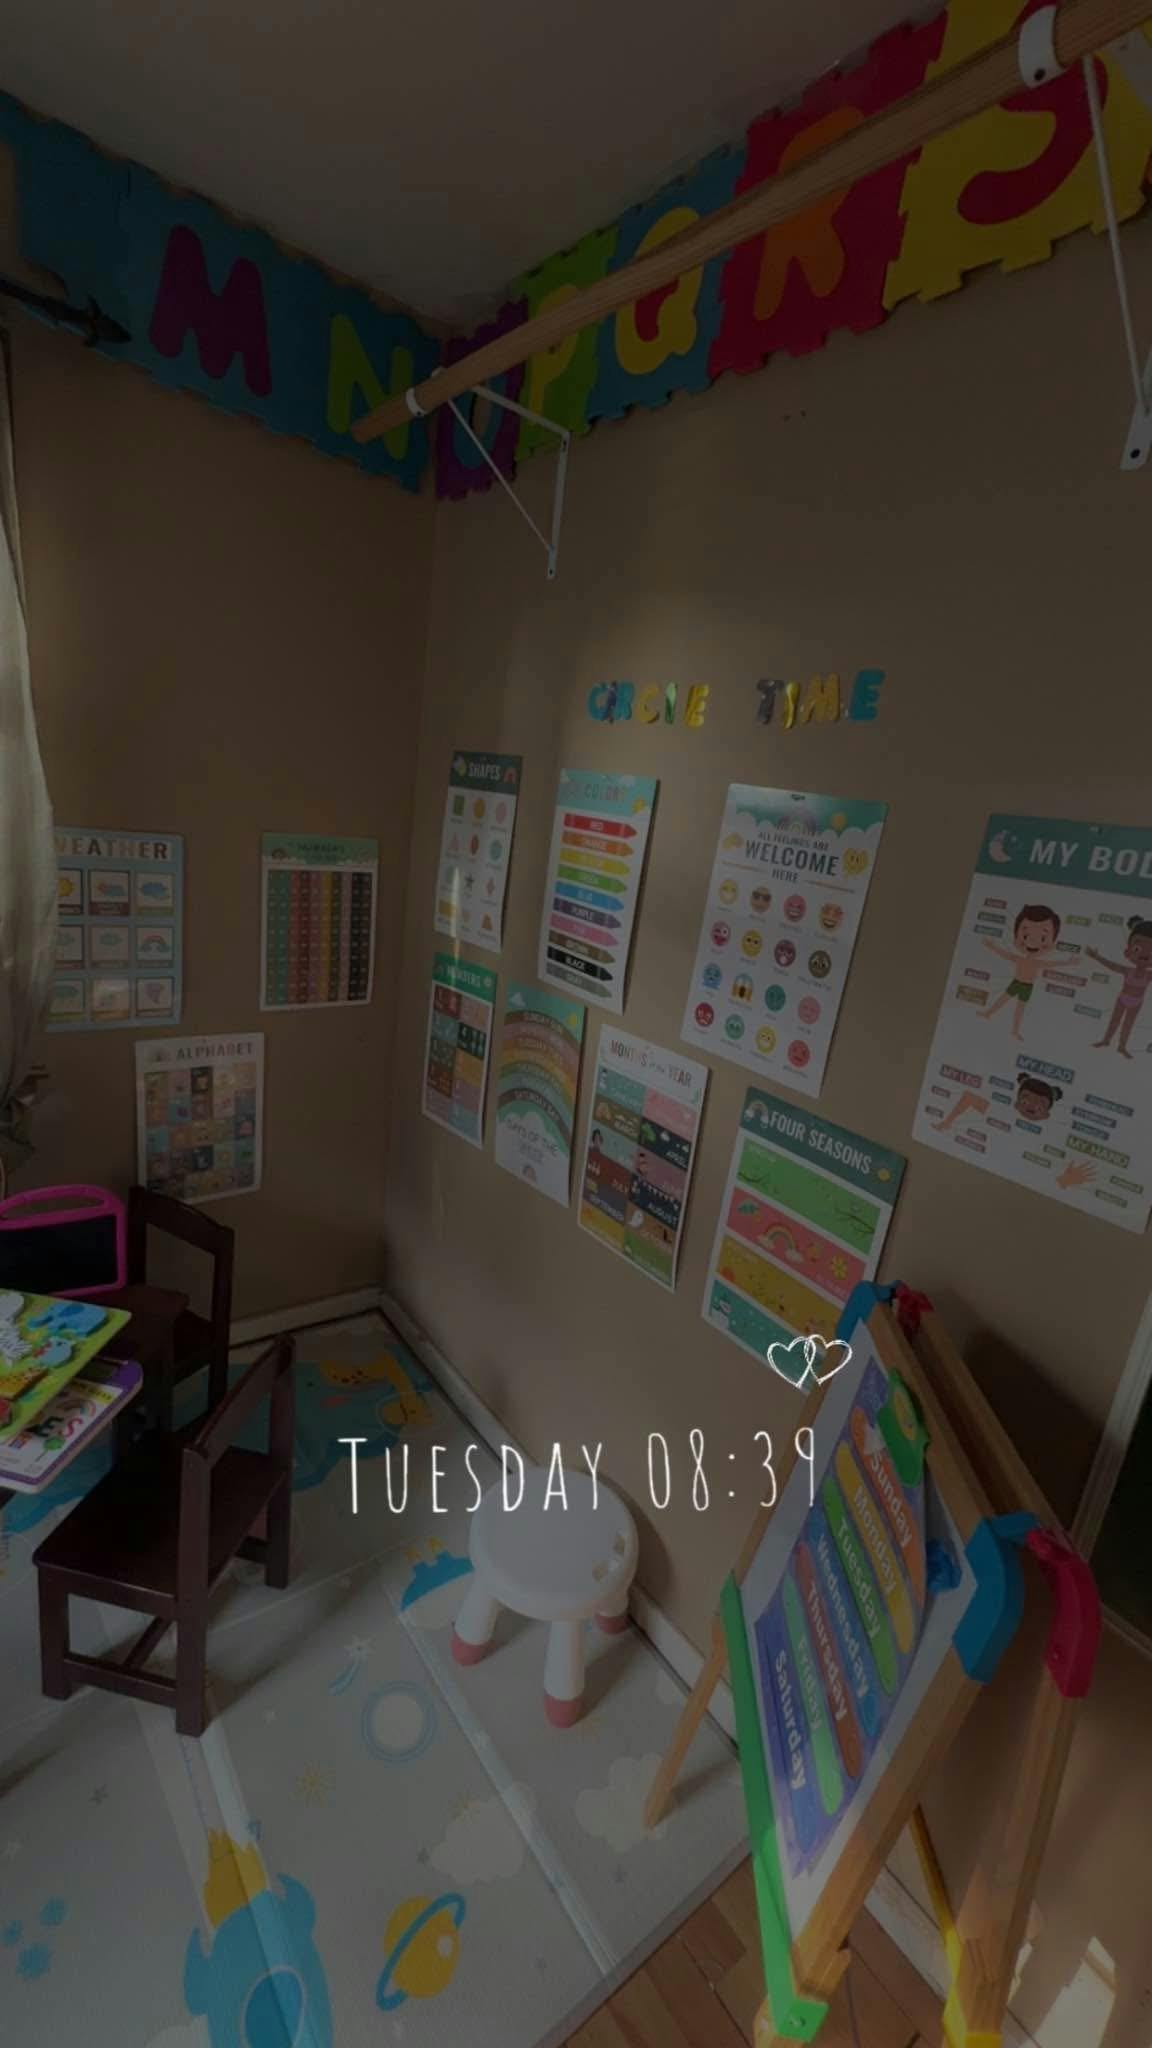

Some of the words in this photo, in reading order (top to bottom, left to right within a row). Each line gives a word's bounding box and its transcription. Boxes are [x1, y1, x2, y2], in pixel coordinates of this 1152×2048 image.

[149, 224, 272, 397] M
[325, 313, 413, 460] N
[756, 669, 885, 730] TIME
[468, 761, 501, 782] SHAPES
[745, 839, 840, 876] WELCOME
[772, 868, 799, 883] HERE
[1029, 838, 1079, 867] MY
[176, 1041, 254, 1061] ALPHABET
[1018, 1055, 1037, 1072] MY
[1039, 1063, 1073, 1083] HEAD
[768, 1110, 808, 1144] FOUR
[808, 1128, 873, 1176] SEASONS
[870, 1451, 913, 1548] Sunday
[837, 1516, 881, 1639] Tuesday
[854, 1486, 896, 1595] Monday
[808, 1580, 848, 1722] Thursday
[817, 1533, 870, 1698] Wednesday
[775, 1649, 806, 1790] Saturday
[798, 1634, 822, 1731] Friday
